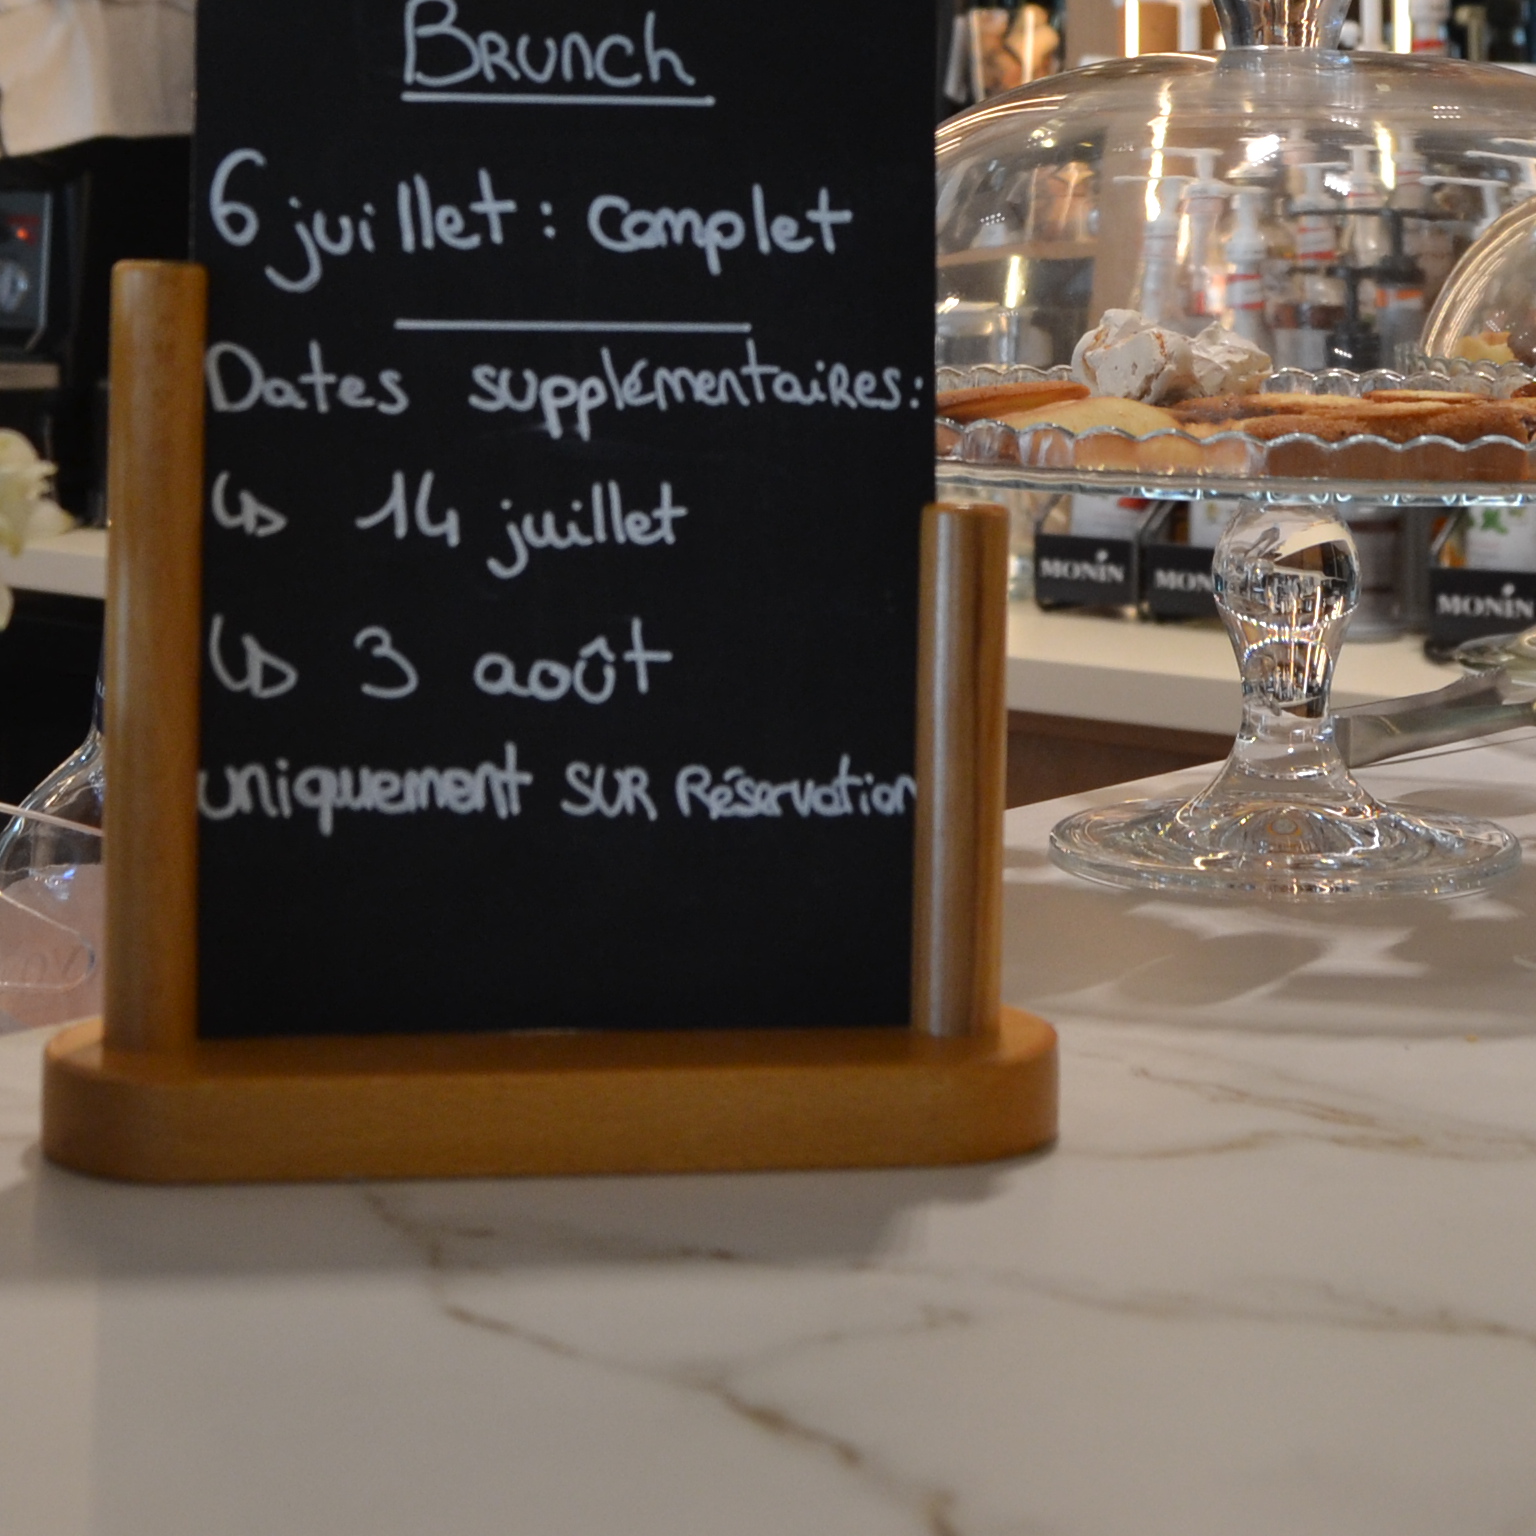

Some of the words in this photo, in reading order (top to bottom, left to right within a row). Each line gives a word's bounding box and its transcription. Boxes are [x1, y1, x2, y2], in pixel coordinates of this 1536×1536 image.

[210, 148, 265, 246] 6
[265, 169, 517, 292] juillet
[205, 341, 409, 415] Dates
[356, 471, 460, 547] 14
[487, 480, 688, 579] juillet
[1154, 569, 1214, 593] MON
[355, 626, 418, 699] 3
[473, 617, 673, 704] août
